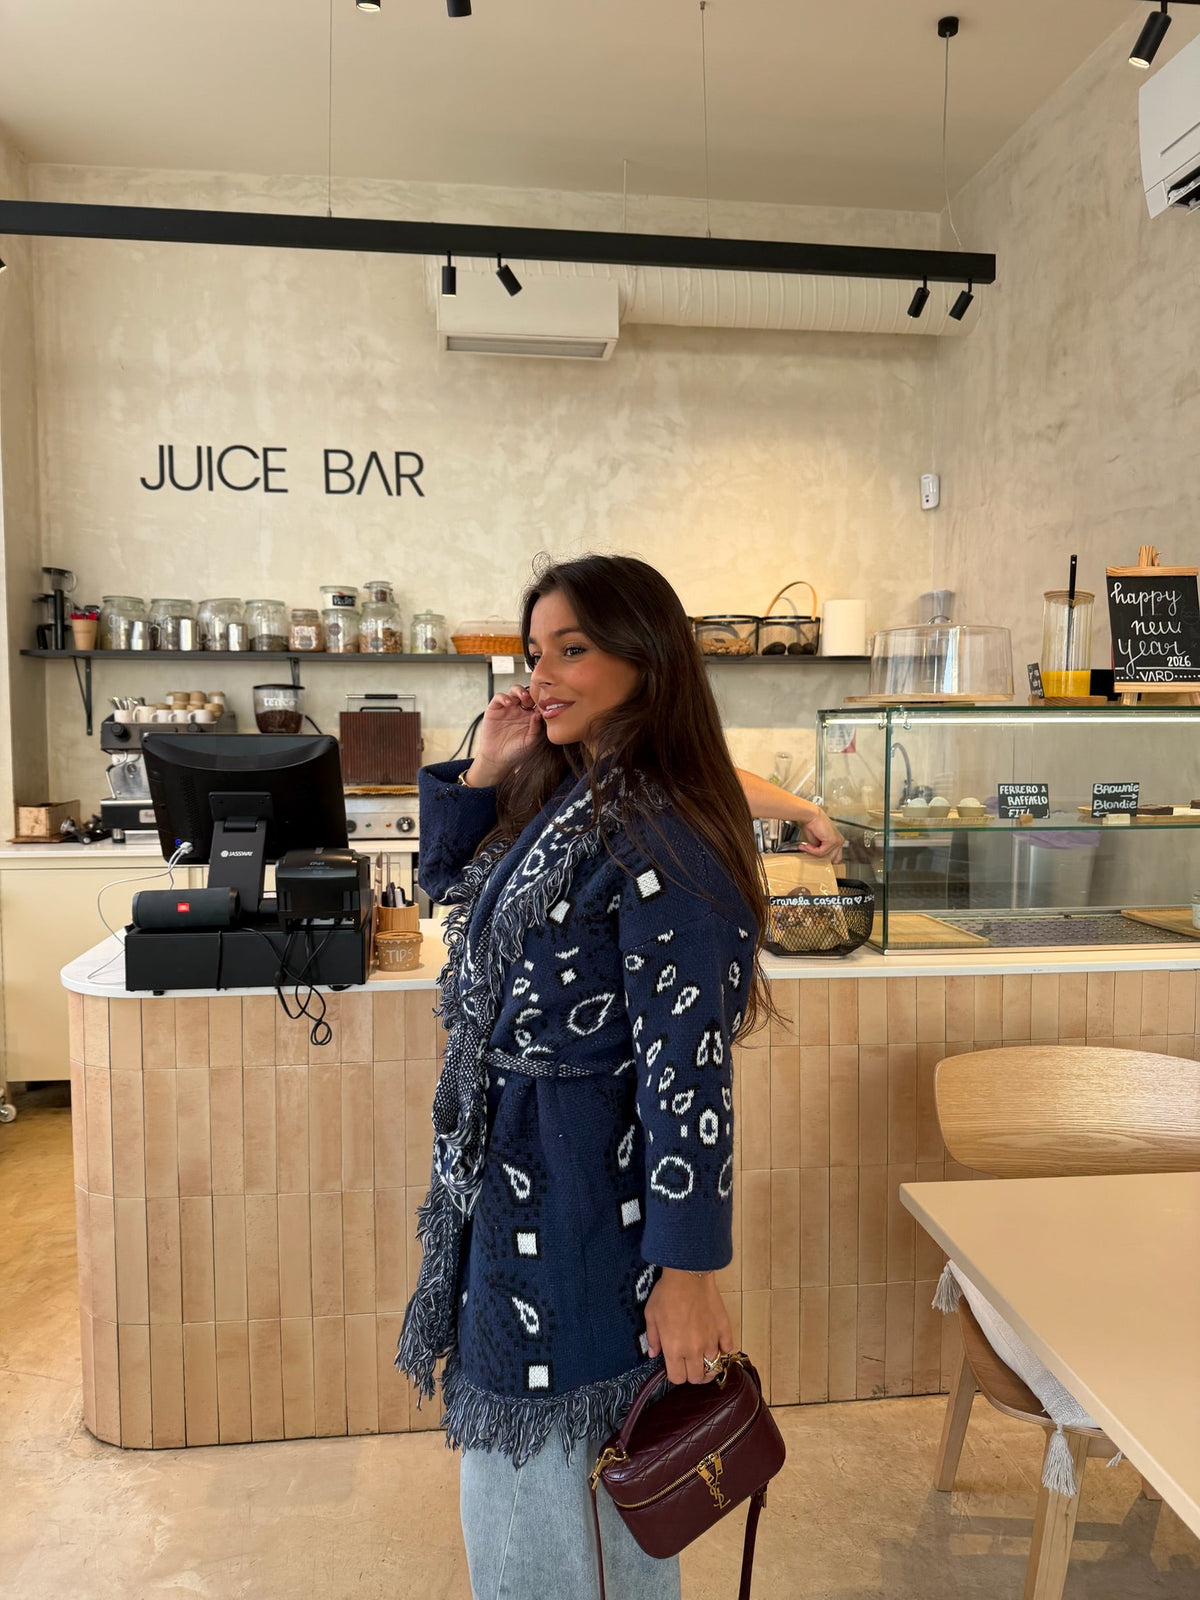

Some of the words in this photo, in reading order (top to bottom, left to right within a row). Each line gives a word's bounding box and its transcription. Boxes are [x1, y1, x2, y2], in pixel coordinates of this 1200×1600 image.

[140, 444, 288, 493] JUICE
[323, 448, 425, 497] BAR
[1110, 582, 1182, 617] happy
[1131, 620, 1181, 635] new
[1167, 655, 1191, 667] 2026
[1000, 785, 1038, 794] FERRERO
[1007, 796, 1048, 805] RAFFAELO
[1093, 799, 1137, 810] Blondie
[813, 895, 854, 905] caseira
[386, 948, 414, 964] TIPS
